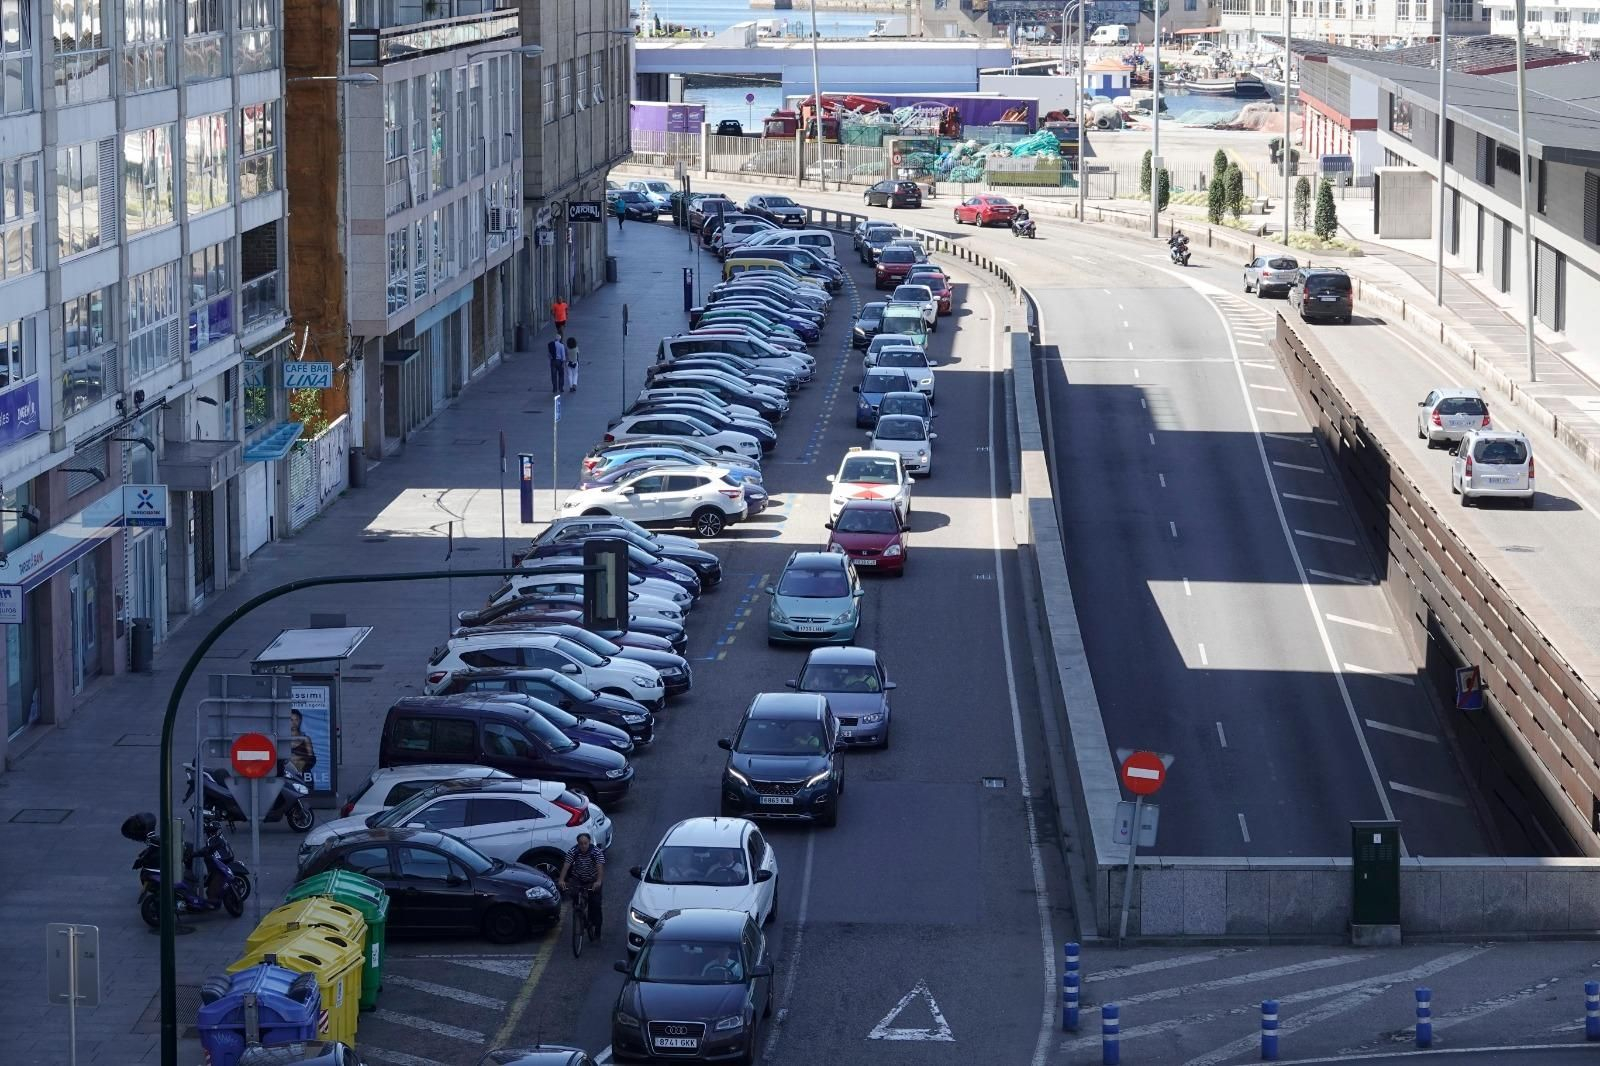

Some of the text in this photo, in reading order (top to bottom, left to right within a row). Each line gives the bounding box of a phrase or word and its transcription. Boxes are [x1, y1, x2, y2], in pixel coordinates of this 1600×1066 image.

[310, 364, 329, 373] BAR
[286, 373, 328, 387] LIÑA
[659, 1038, 695, 1047] 8741 GKK
